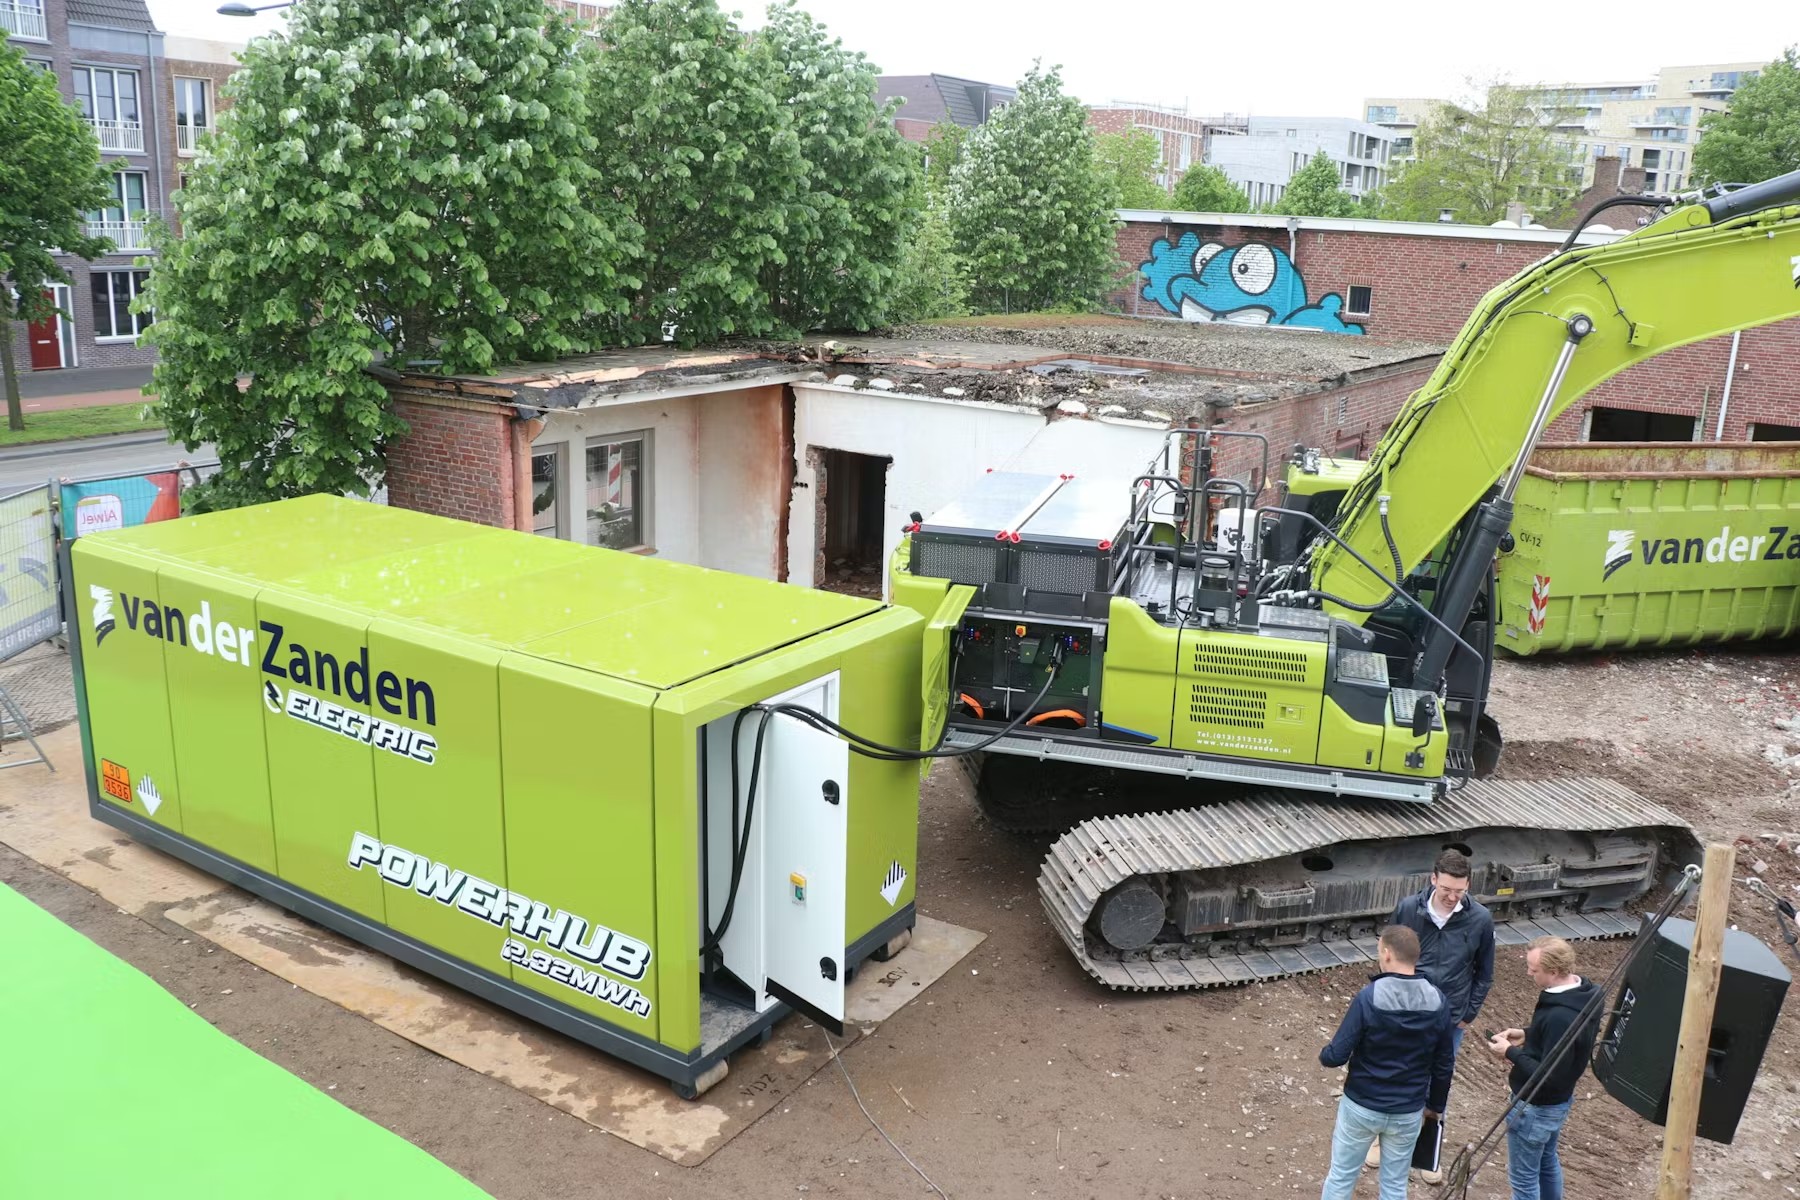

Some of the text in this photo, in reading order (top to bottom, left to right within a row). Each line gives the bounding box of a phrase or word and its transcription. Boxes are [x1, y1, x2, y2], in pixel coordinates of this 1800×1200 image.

[1519, 532, 1541, 548] CV-12
[286, 689, 438, 765] ELECTRIC
[349, 832, 652, 981] POWERHUB
[501, 938, 651, 1018] 2.32MWh
